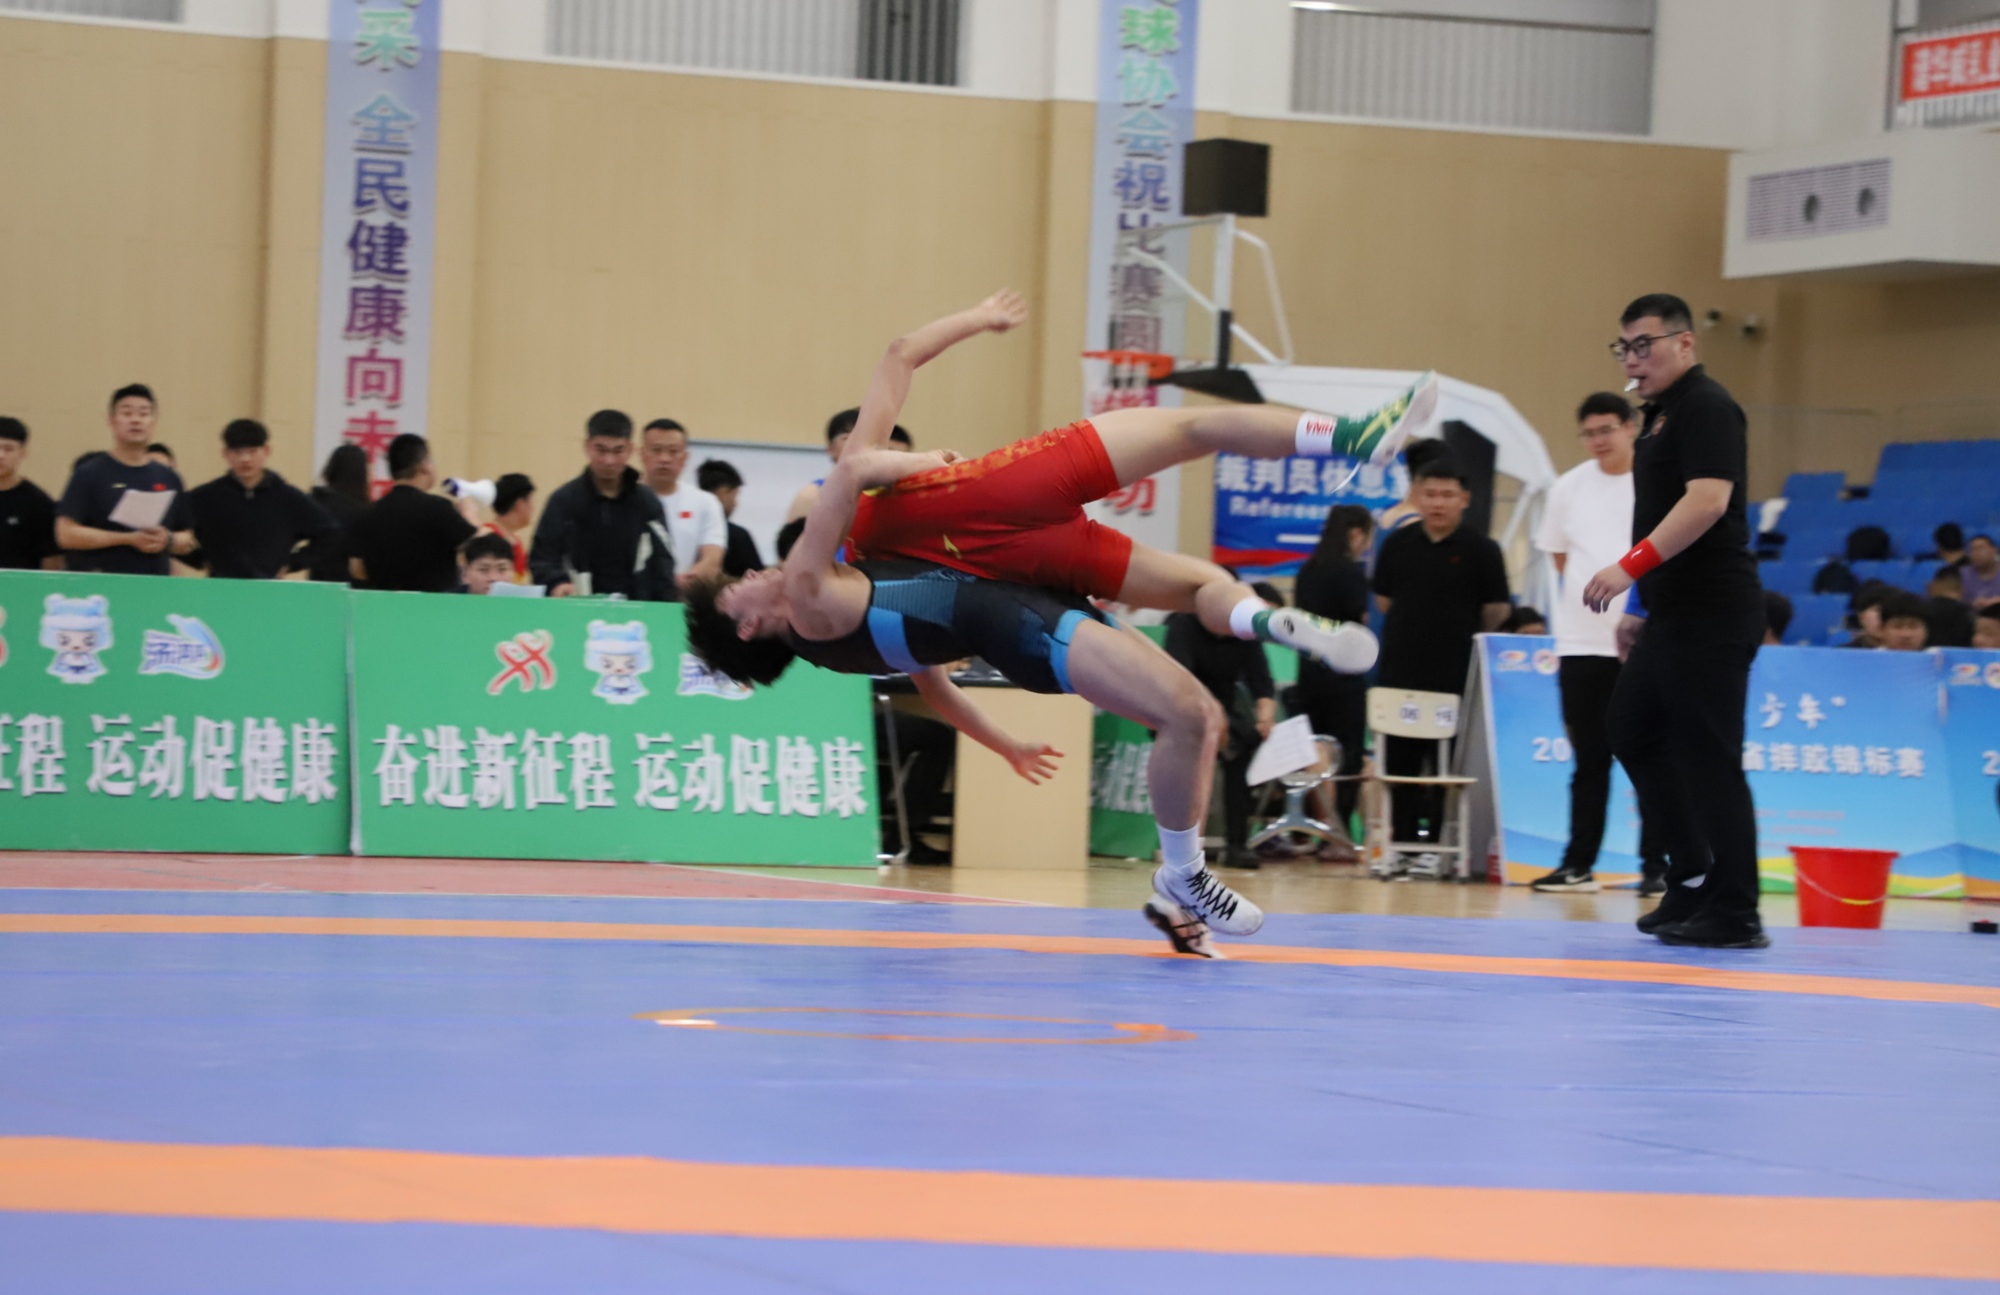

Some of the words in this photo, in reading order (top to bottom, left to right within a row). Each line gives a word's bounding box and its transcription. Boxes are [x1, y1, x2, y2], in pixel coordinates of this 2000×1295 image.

[353, 0, 421, 71] 采
[86, 714, 338, 803] 运动促健康
[373, 724, 617, 811] 奋进新征程
[634, 733, 868, 818] 运动促健康
